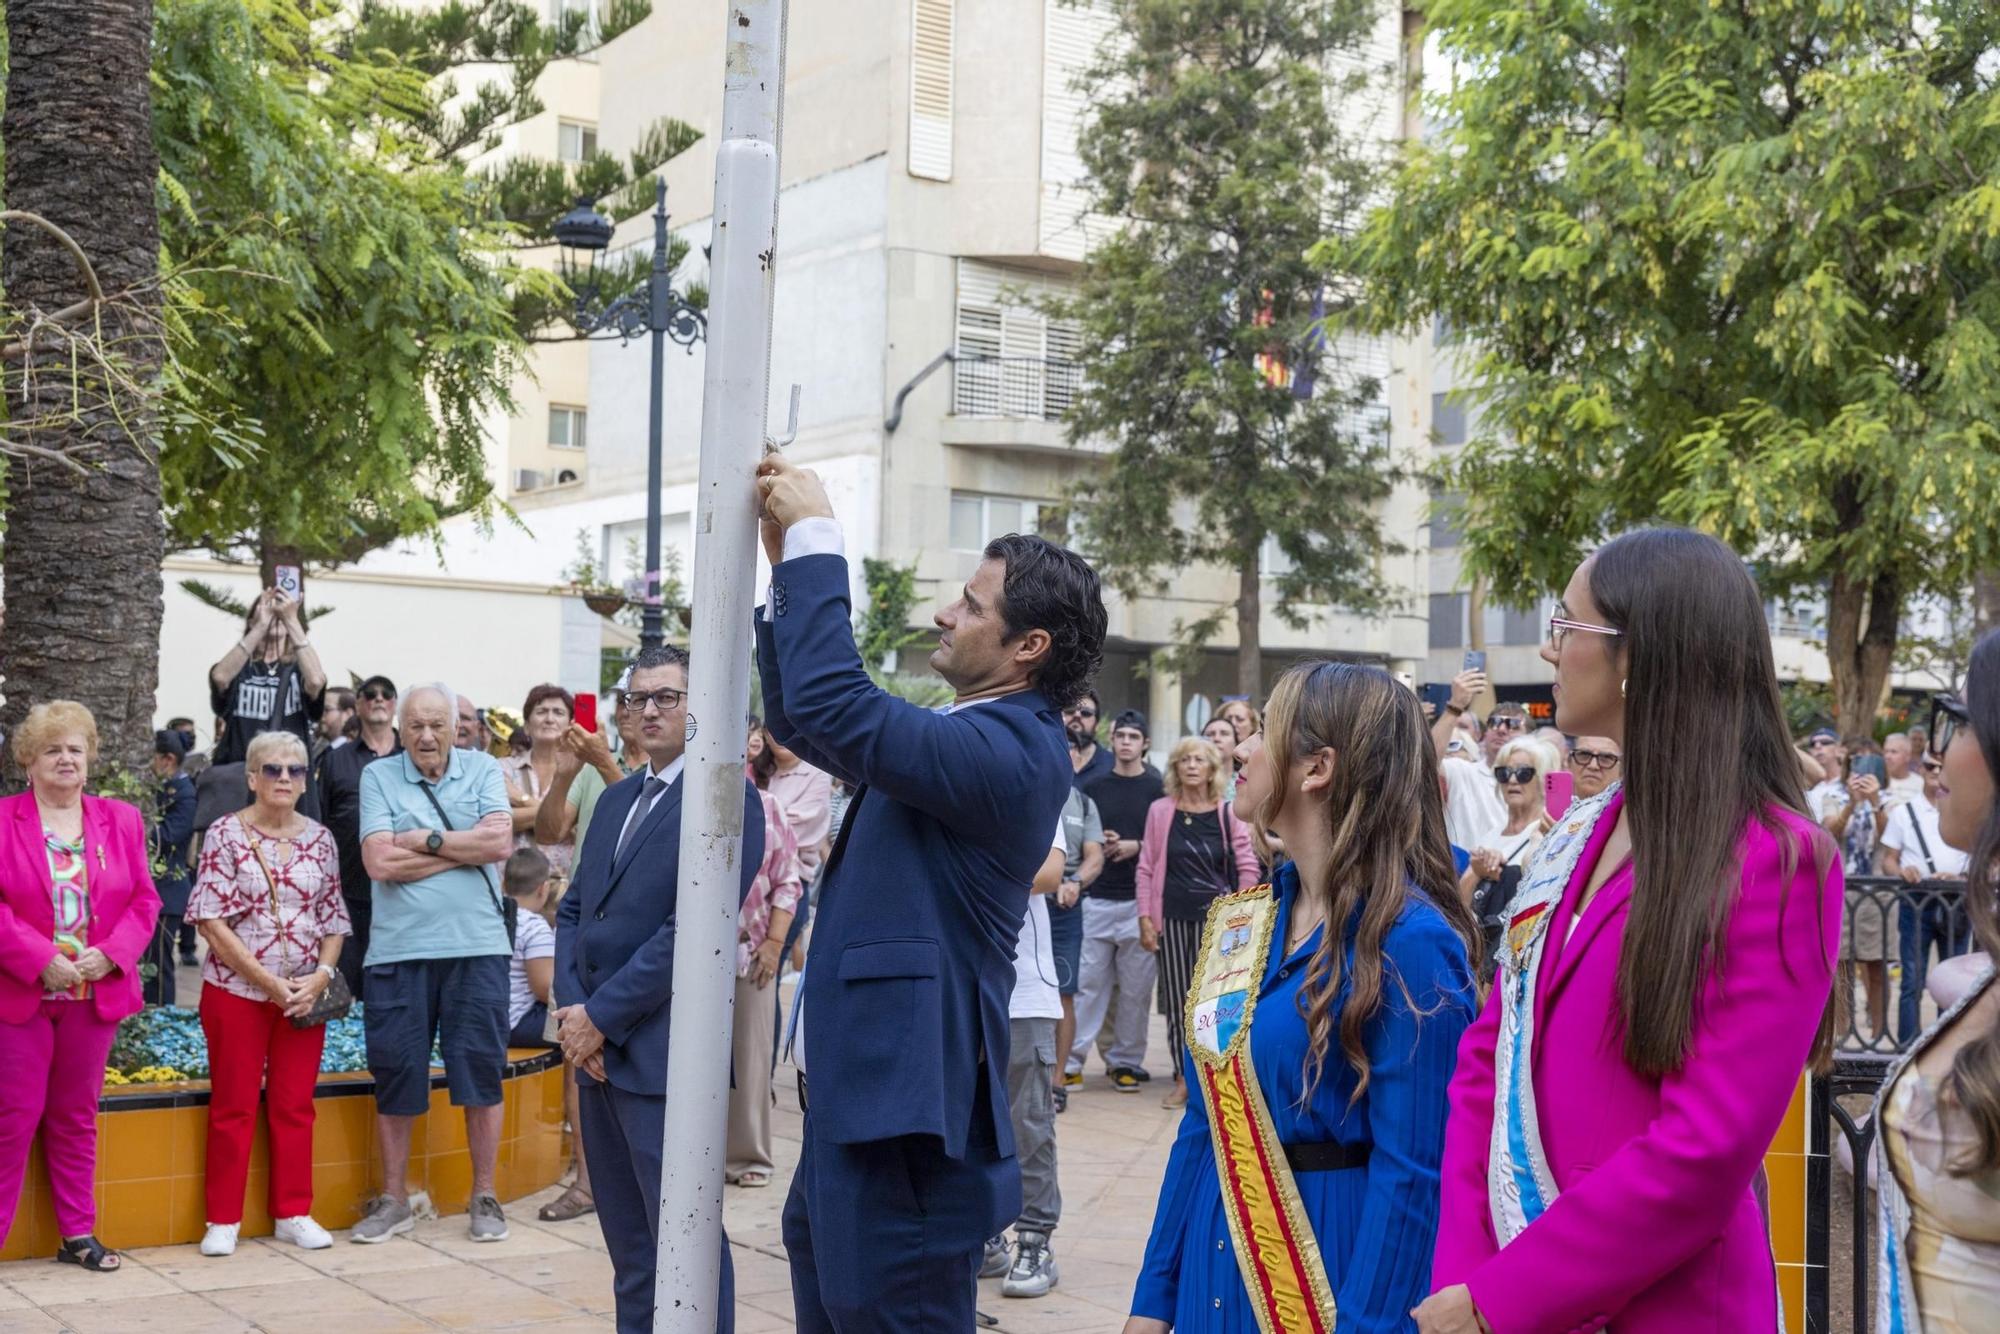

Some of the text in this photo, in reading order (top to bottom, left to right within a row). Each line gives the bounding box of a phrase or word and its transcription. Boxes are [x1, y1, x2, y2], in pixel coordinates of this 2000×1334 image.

[1214, 1074, 1304, 1333] Reina de la
